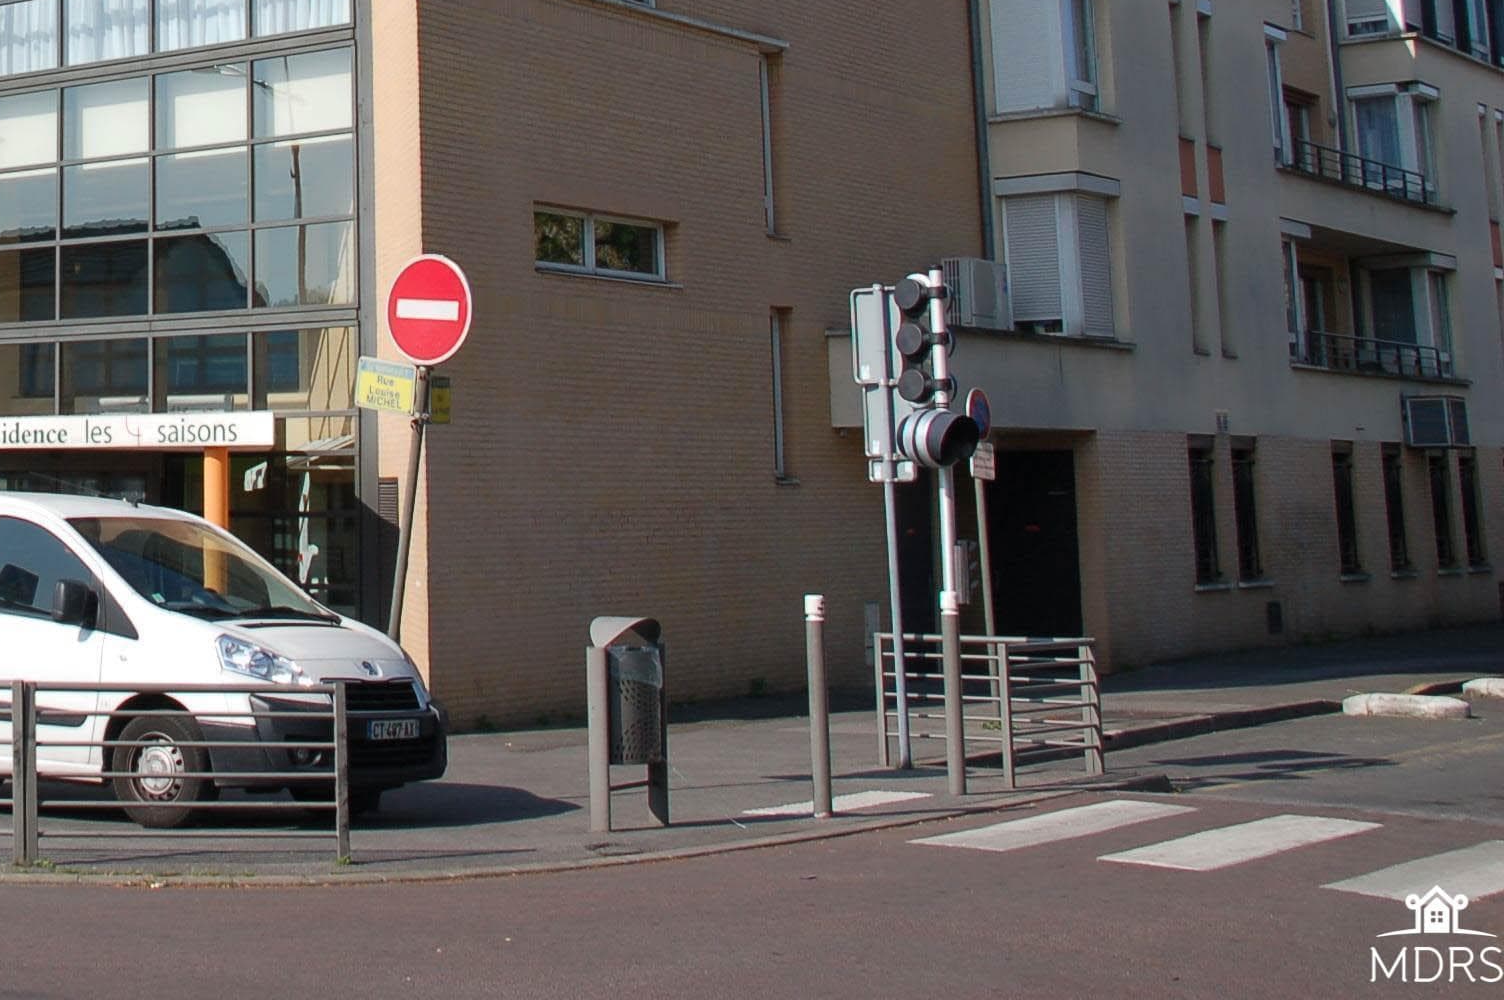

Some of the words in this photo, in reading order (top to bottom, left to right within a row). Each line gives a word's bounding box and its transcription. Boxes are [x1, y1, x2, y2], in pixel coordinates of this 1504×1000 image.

[377, 375, 394, 387] Rue
[369, 384, 400, 400] Louise
[85, 419, 112, 443] les
[157, 418, 238, 443] saisons
